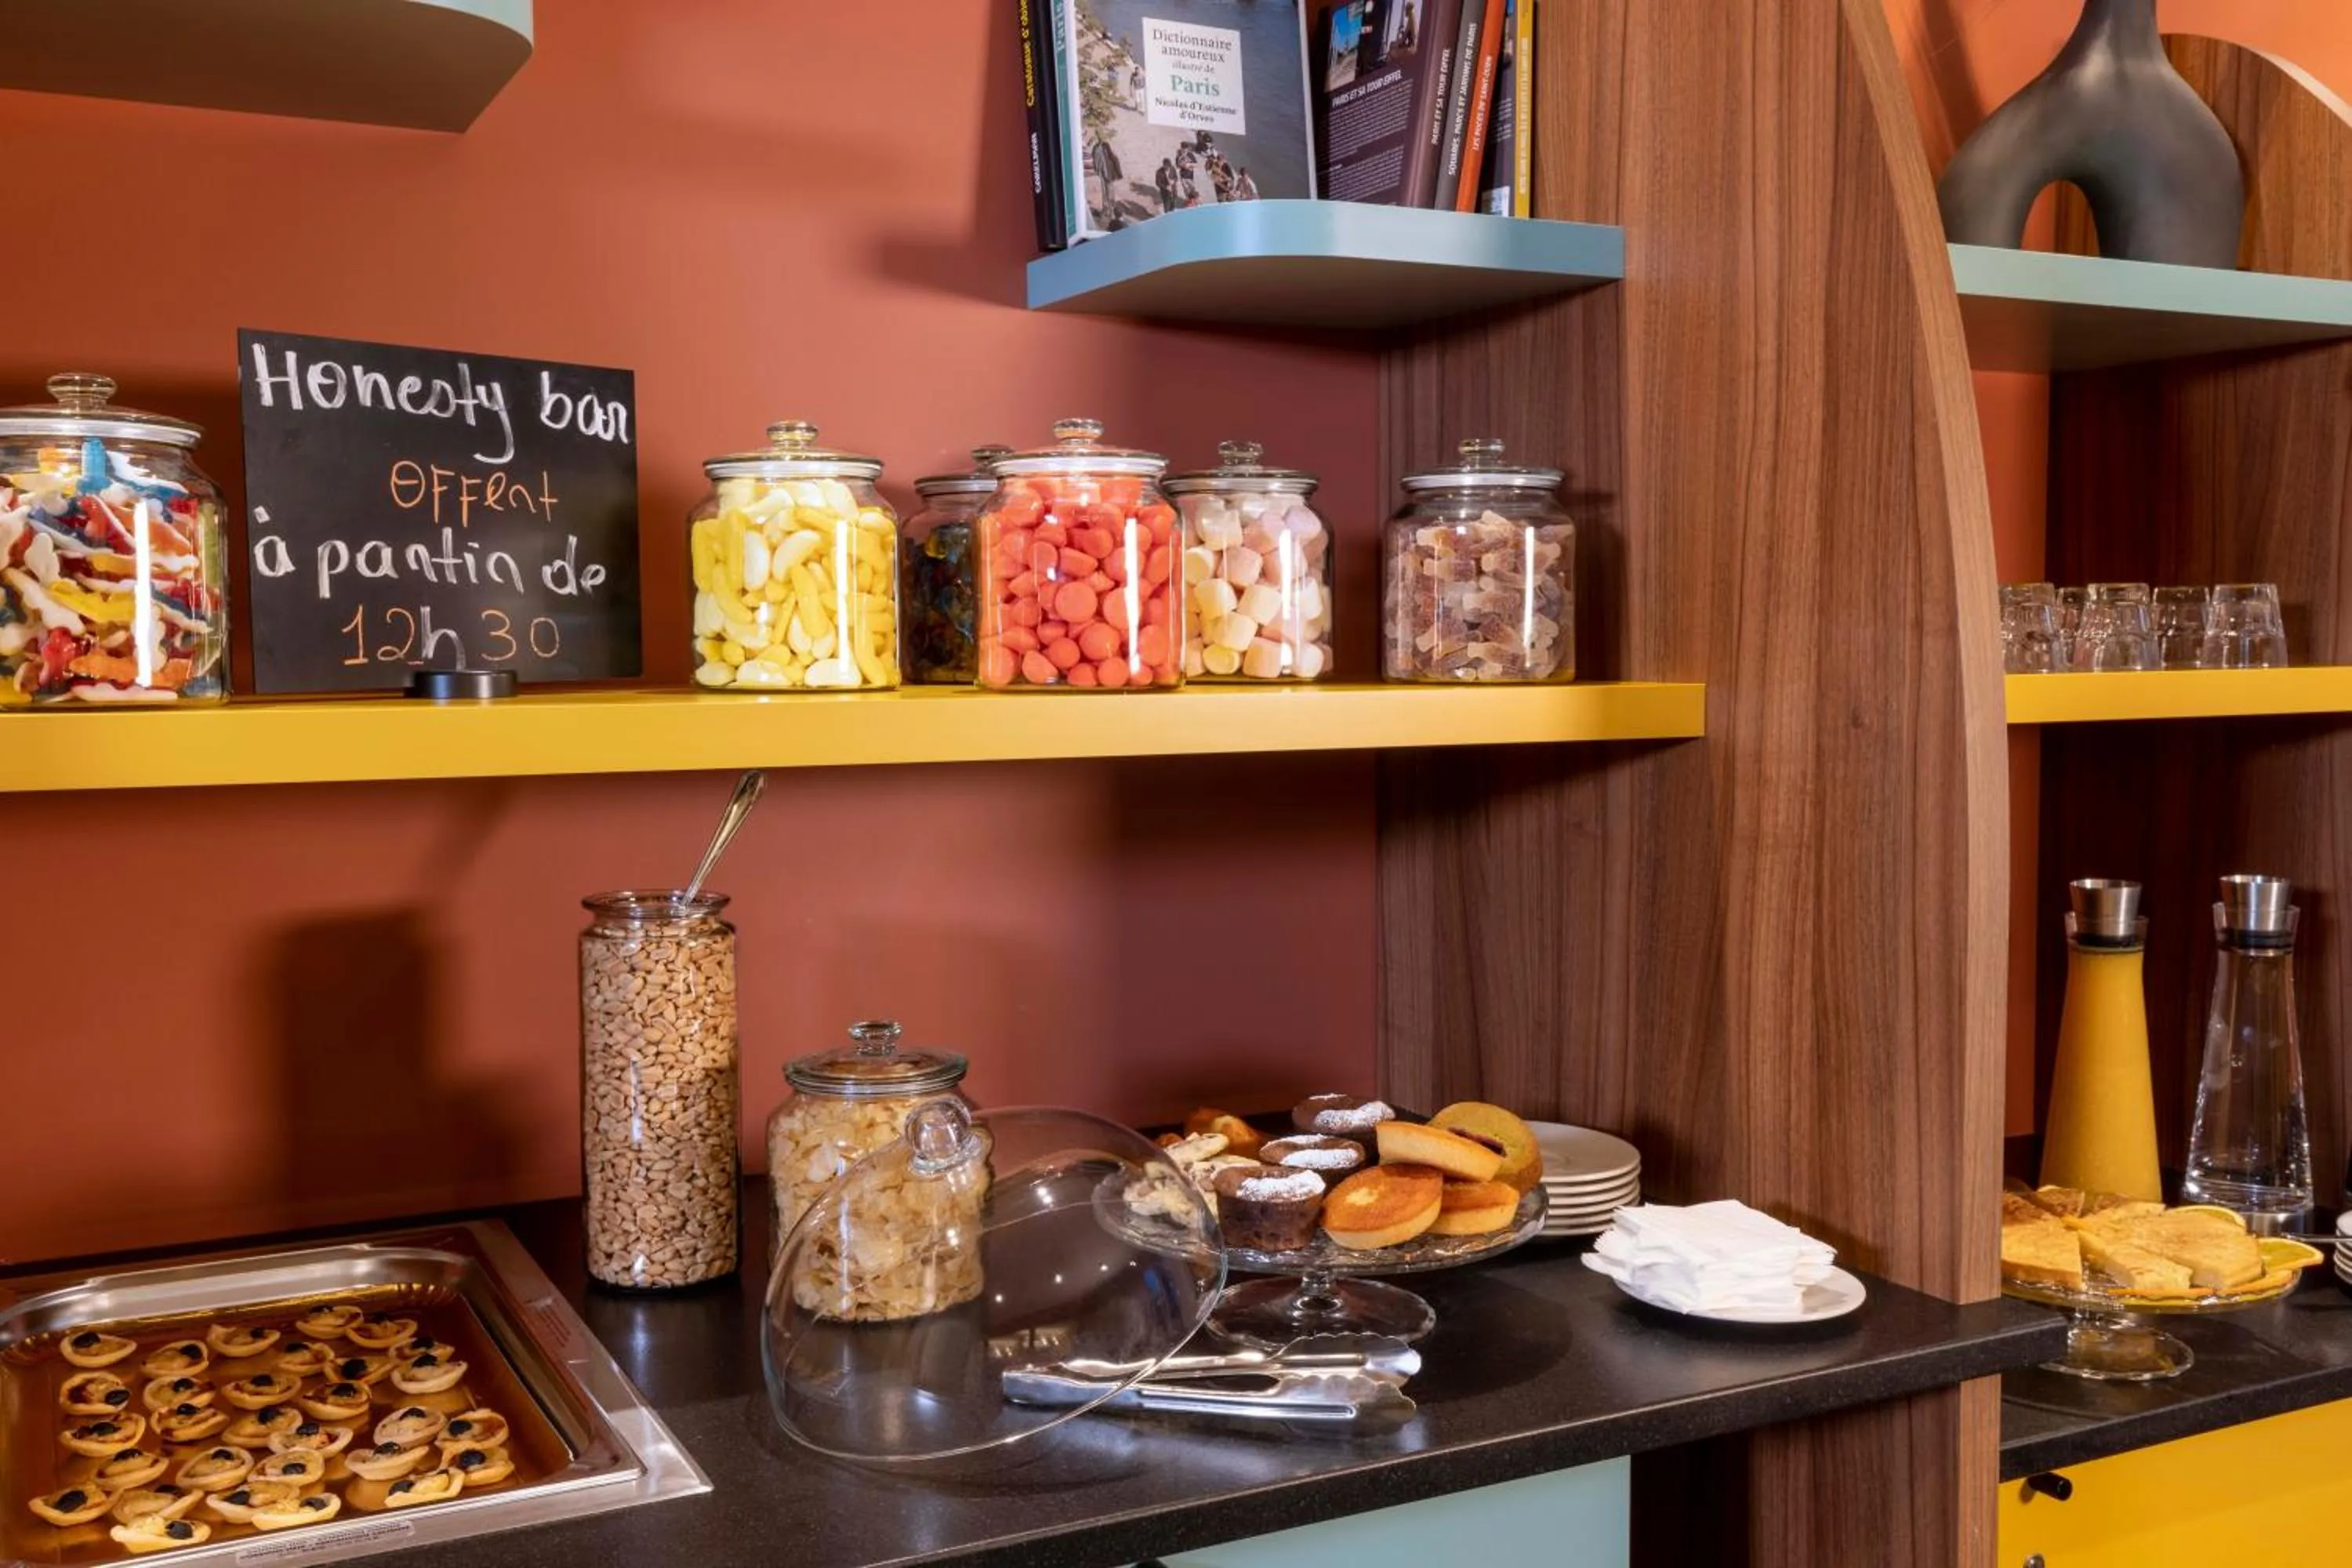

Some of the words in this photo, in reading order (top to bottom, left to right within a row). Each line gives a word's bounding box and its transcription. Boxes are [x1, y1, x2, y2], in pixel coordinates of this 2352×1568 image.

[1152, 28, 1232, 51] Dictionnaire
[1161, 45, 1225, 64] amoureux
[1204, 64, 1215, 74] de
[1171, 74, 1221, 96] Paris
[1155, 96, 1188, 109] Nicolas
[252, 343, 514, 464] Honesty
[540, 371, 630, 444] bar
[252, 505, 296, 578] à
[317, 527, 524, 599] partir
[542, 535, 607, 596] de
